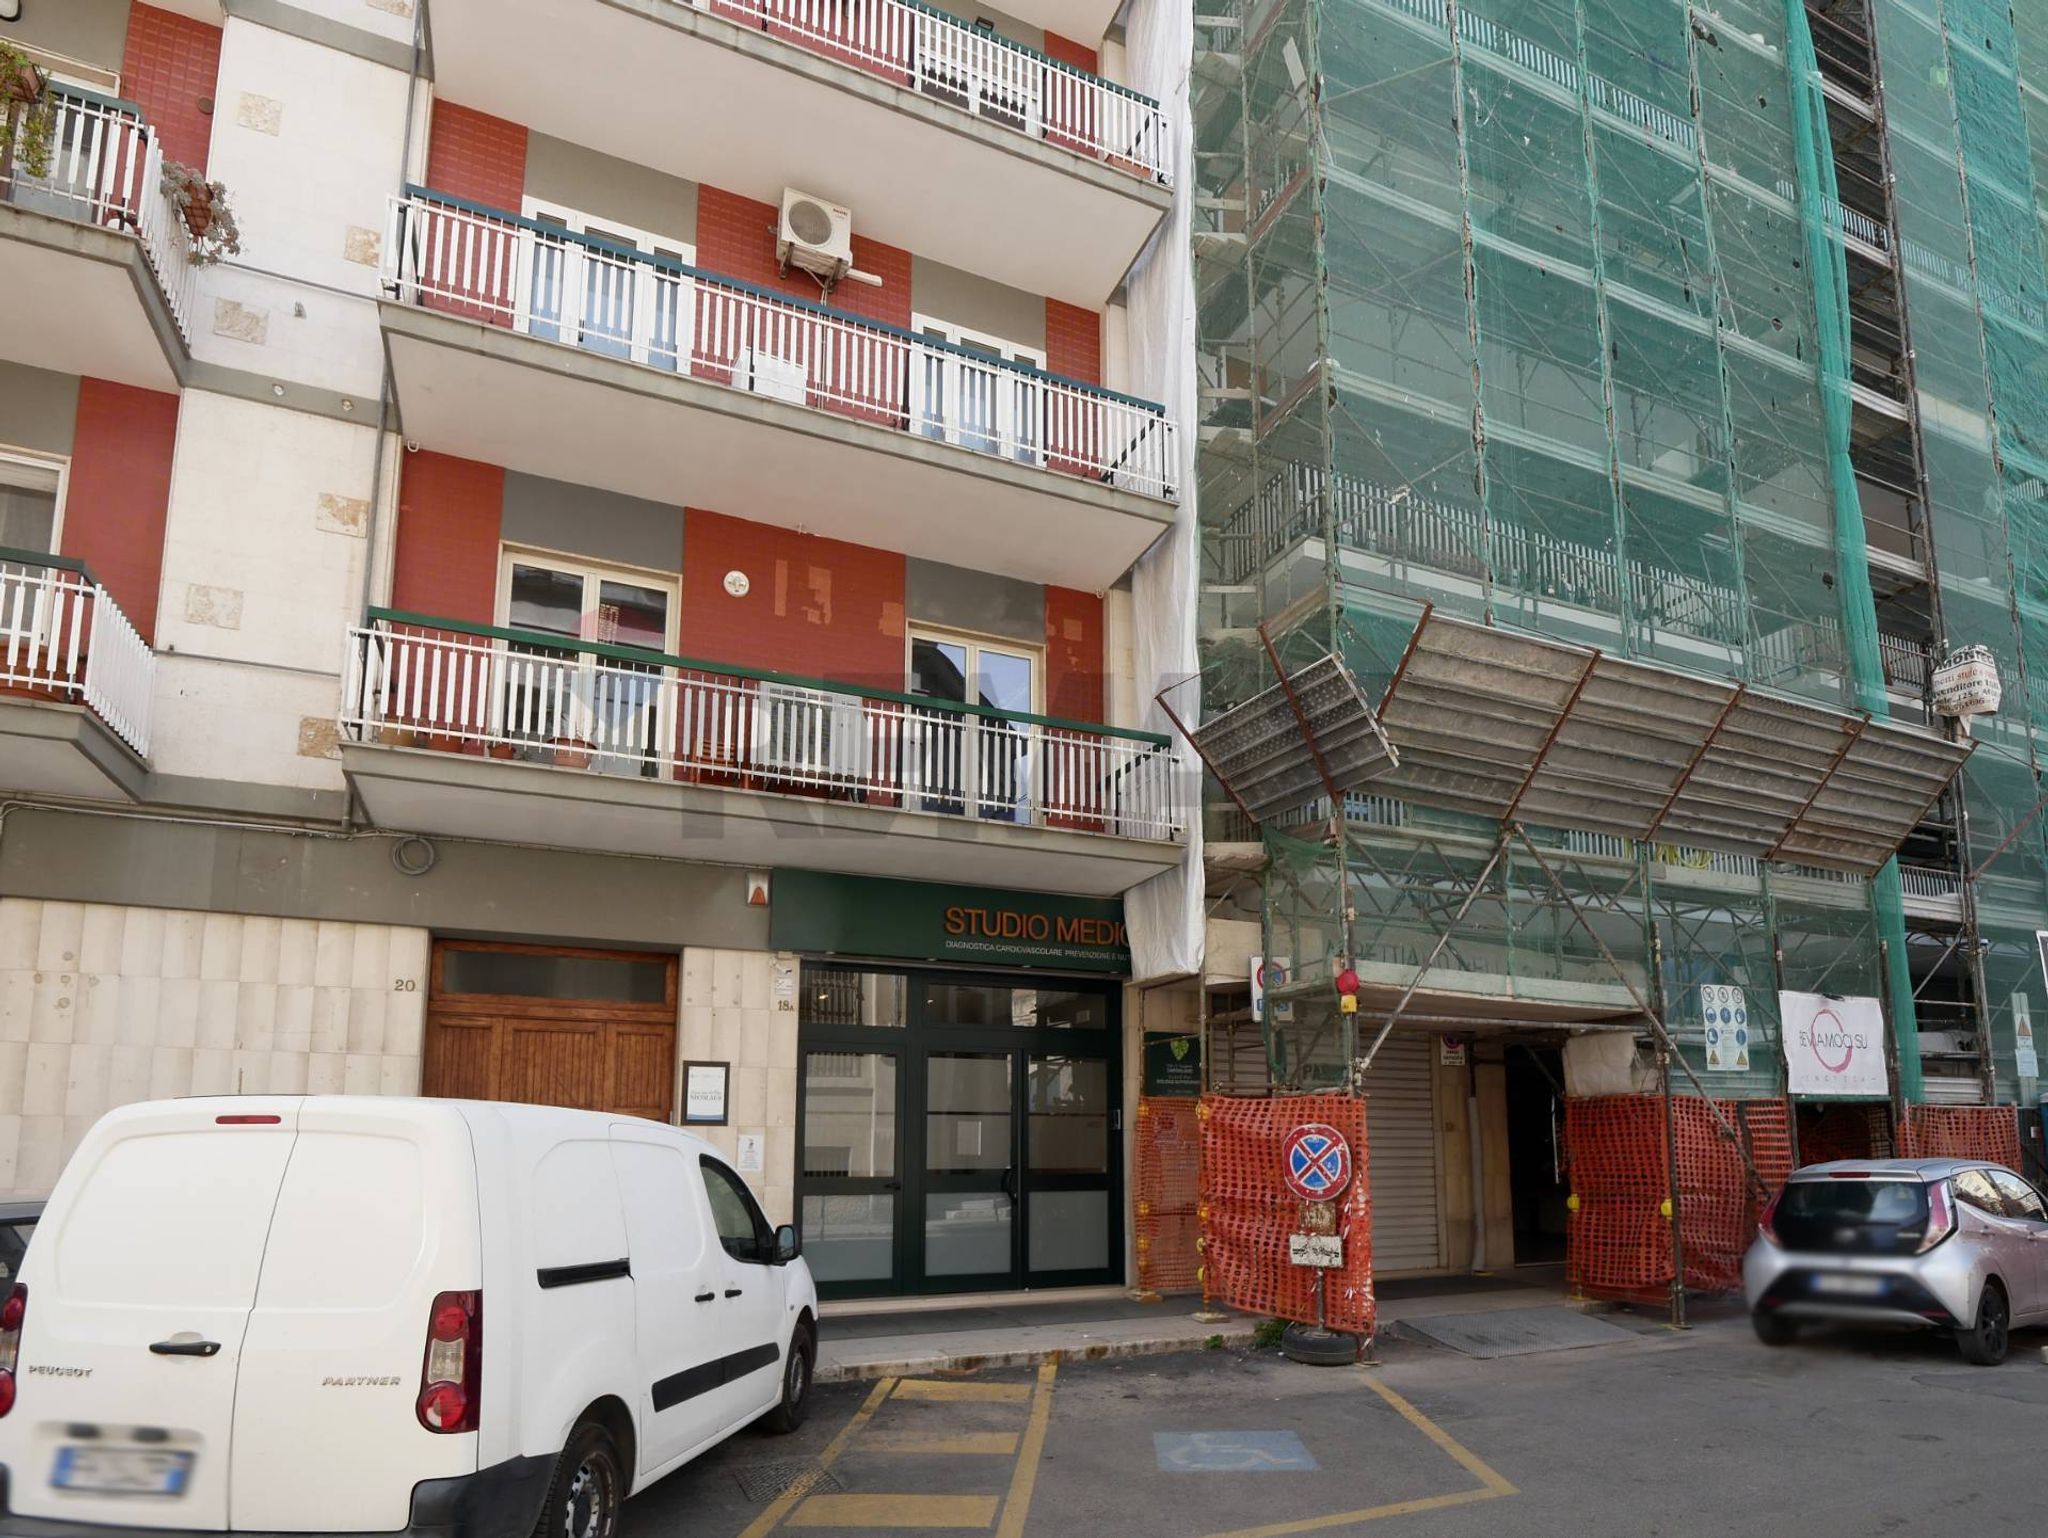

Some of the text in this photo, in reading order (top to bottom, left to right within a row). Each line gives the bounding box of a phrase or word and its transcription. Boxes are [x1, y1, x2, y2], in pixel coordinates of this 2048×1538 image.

[945, 906, 1049, 940] STUDIO
[945, 940, 995, 951] DIAGNOSTICA
[995, 944, 1063, 957] CARDIOVASCOLARE
[1064, 949, 1111, 960] PREVENZIONE
[394, 978, 416, 992] 20
[1854, 1033, 1868, 1049] SU
[28, 1365, 93, 1377] PEUGEOT
[321, 1376, 401, 1387] PARTNER
